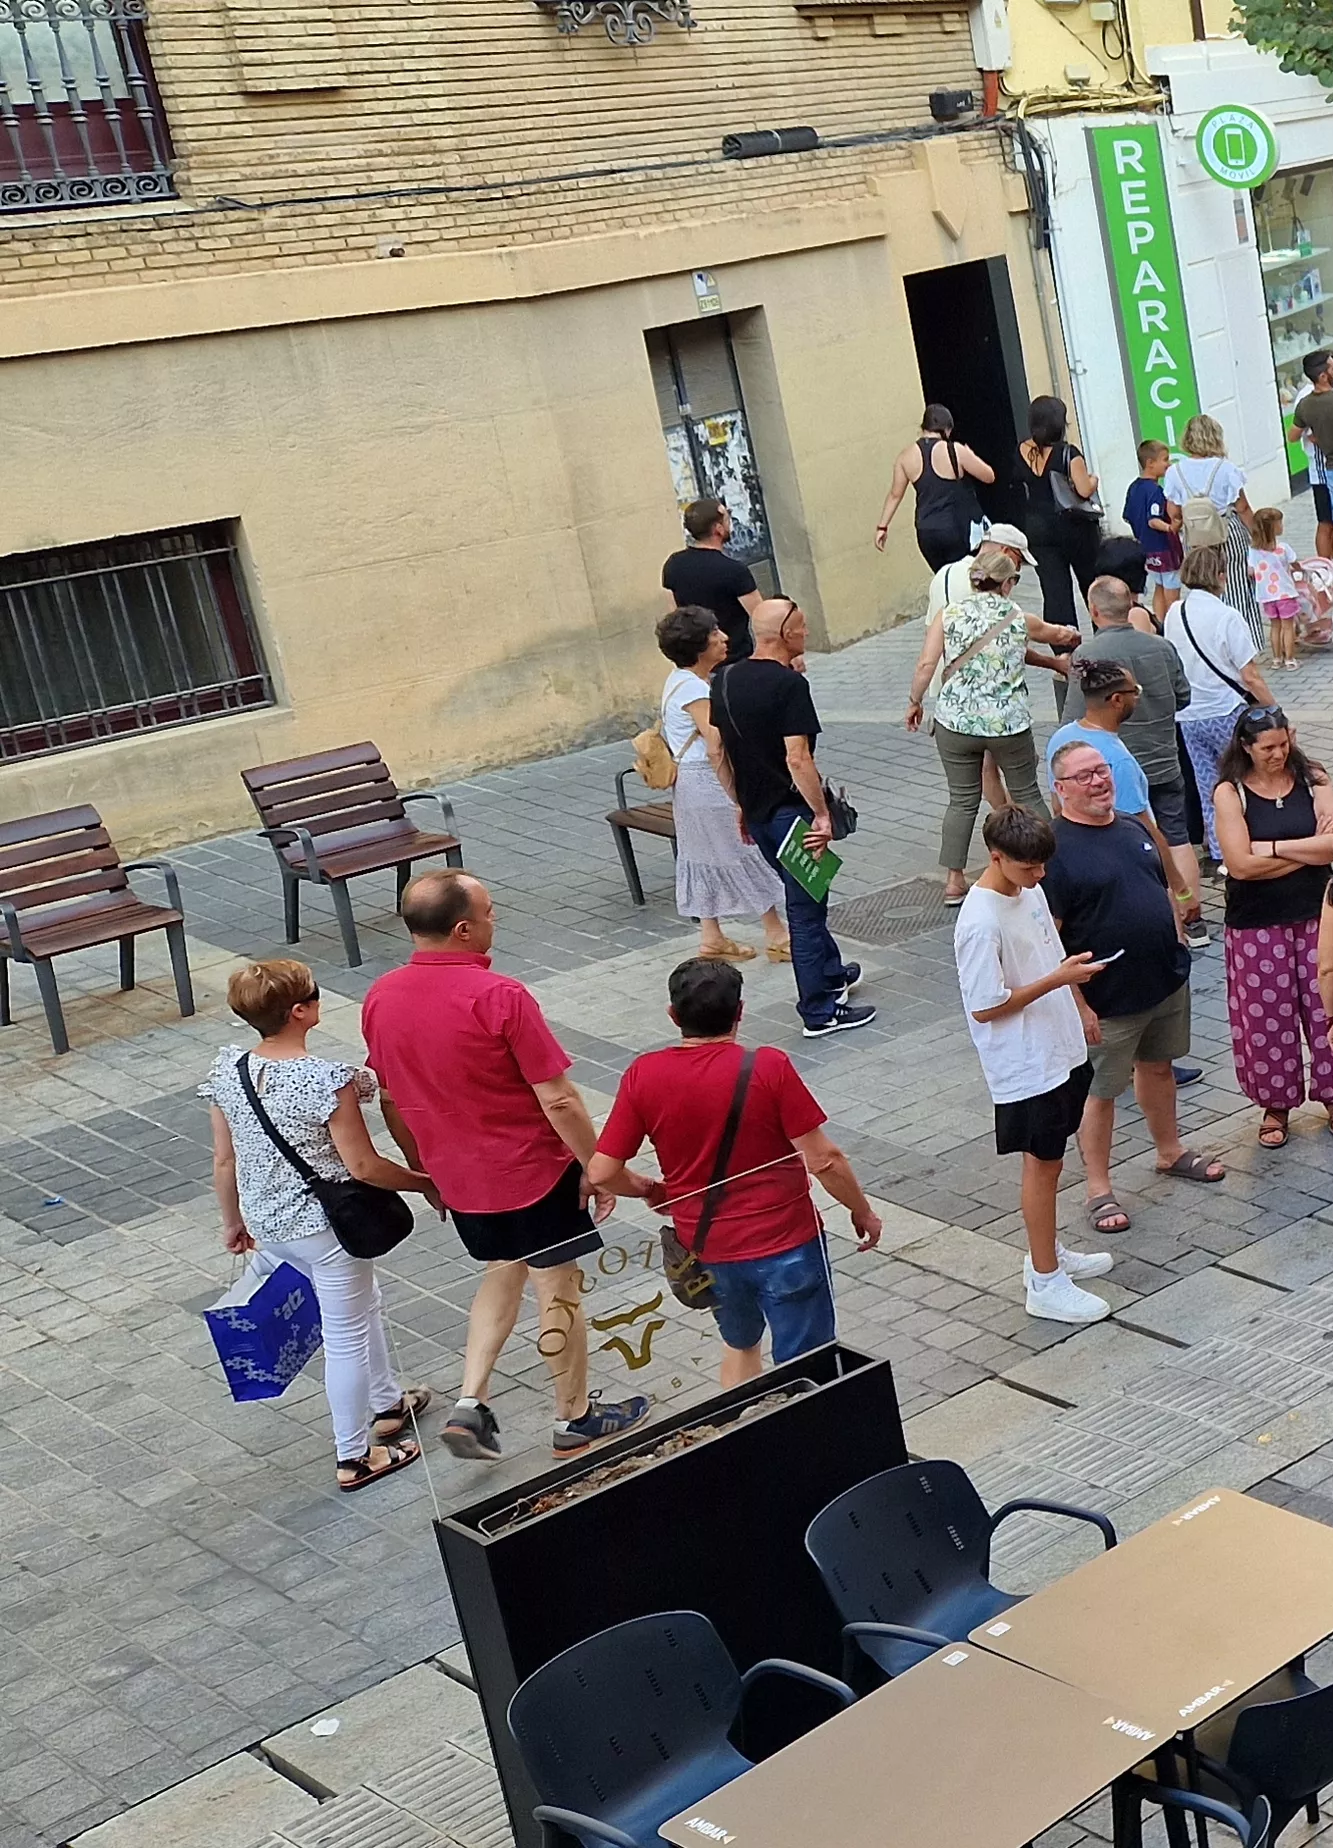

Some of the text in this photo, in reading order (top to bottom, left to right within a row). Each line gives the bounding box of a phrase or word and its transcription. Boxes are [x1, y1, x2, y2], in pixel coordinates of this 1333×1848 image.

[1211, 114, 1255, 130] PLAZA
[1178, 1685, 1226, 1718] AMBAR
[684, 1817, 728, 1841] AMBAR
